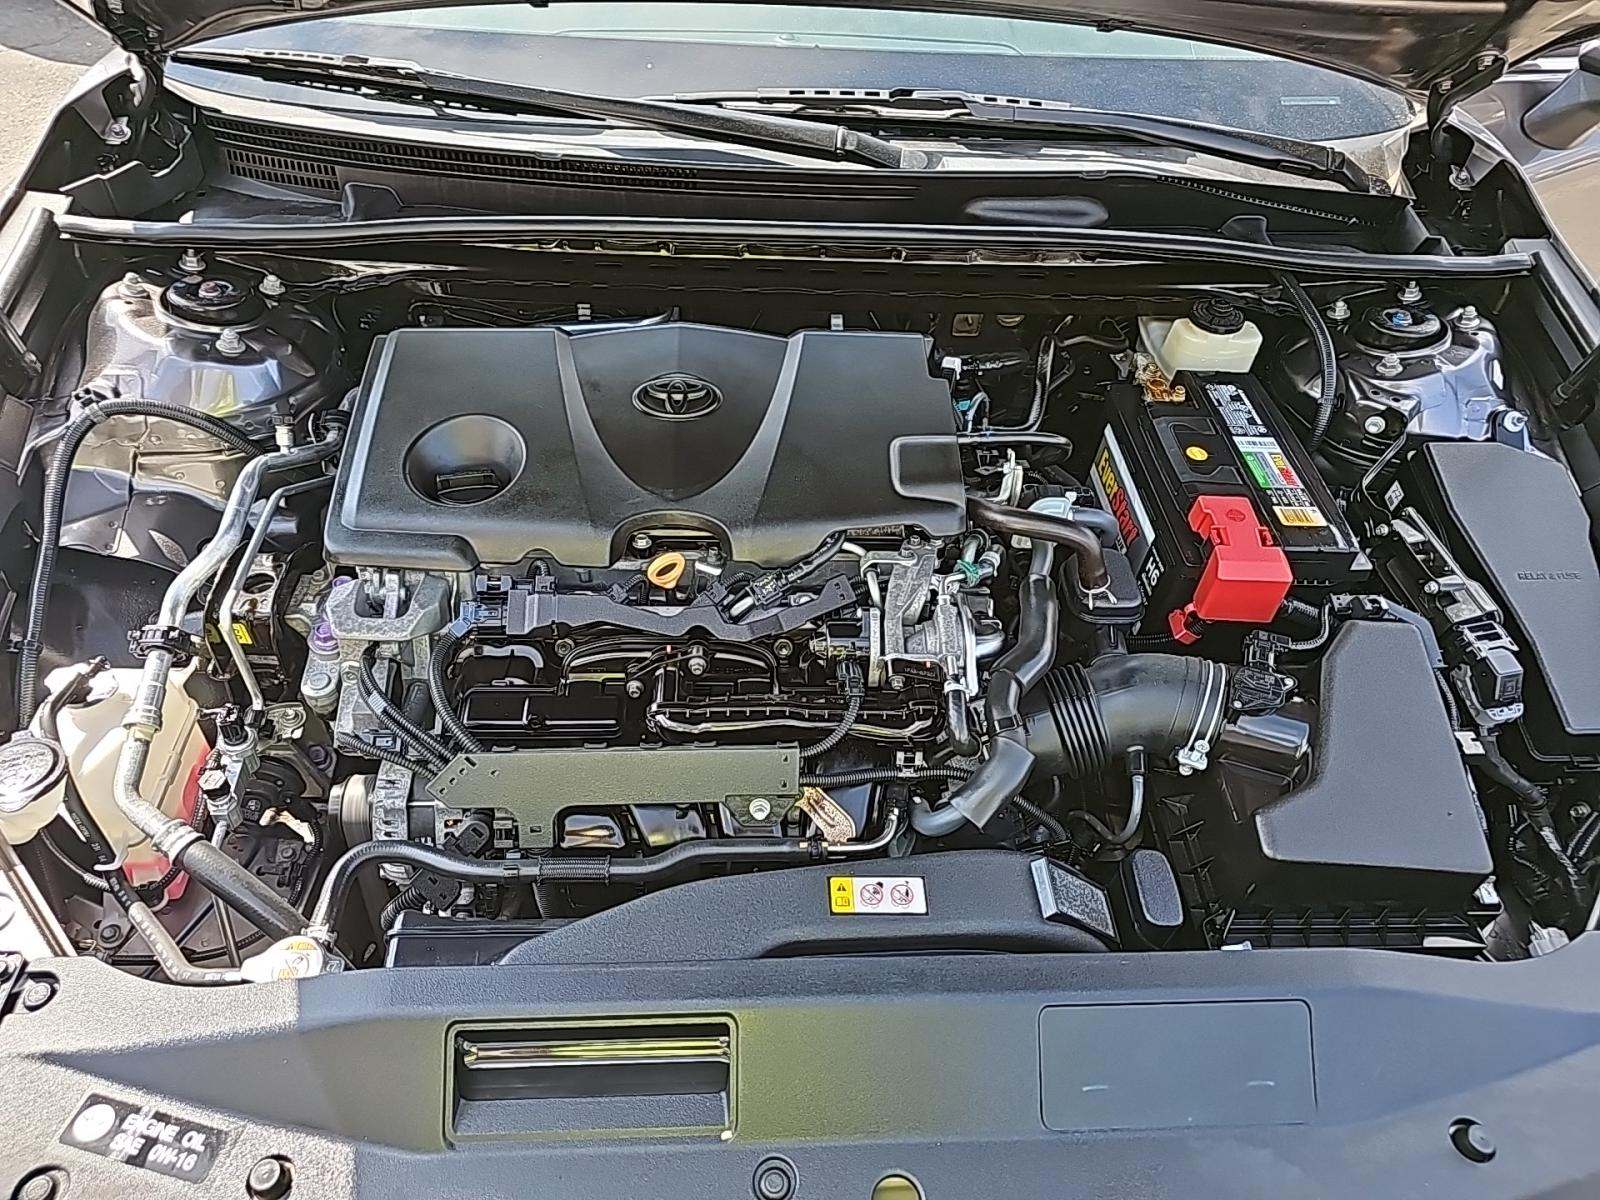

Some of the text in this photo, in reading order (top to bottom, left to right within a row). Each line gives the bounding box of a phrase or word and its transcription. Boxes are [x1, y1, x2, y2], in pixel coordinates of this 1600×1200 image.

[1097, 448, 1141, 546] EverStart
[1145, 556, 1160, 586] H6
[120, 1112, 181, 1143] ENGINE
[109, 1132, 146, 1156] SAE
